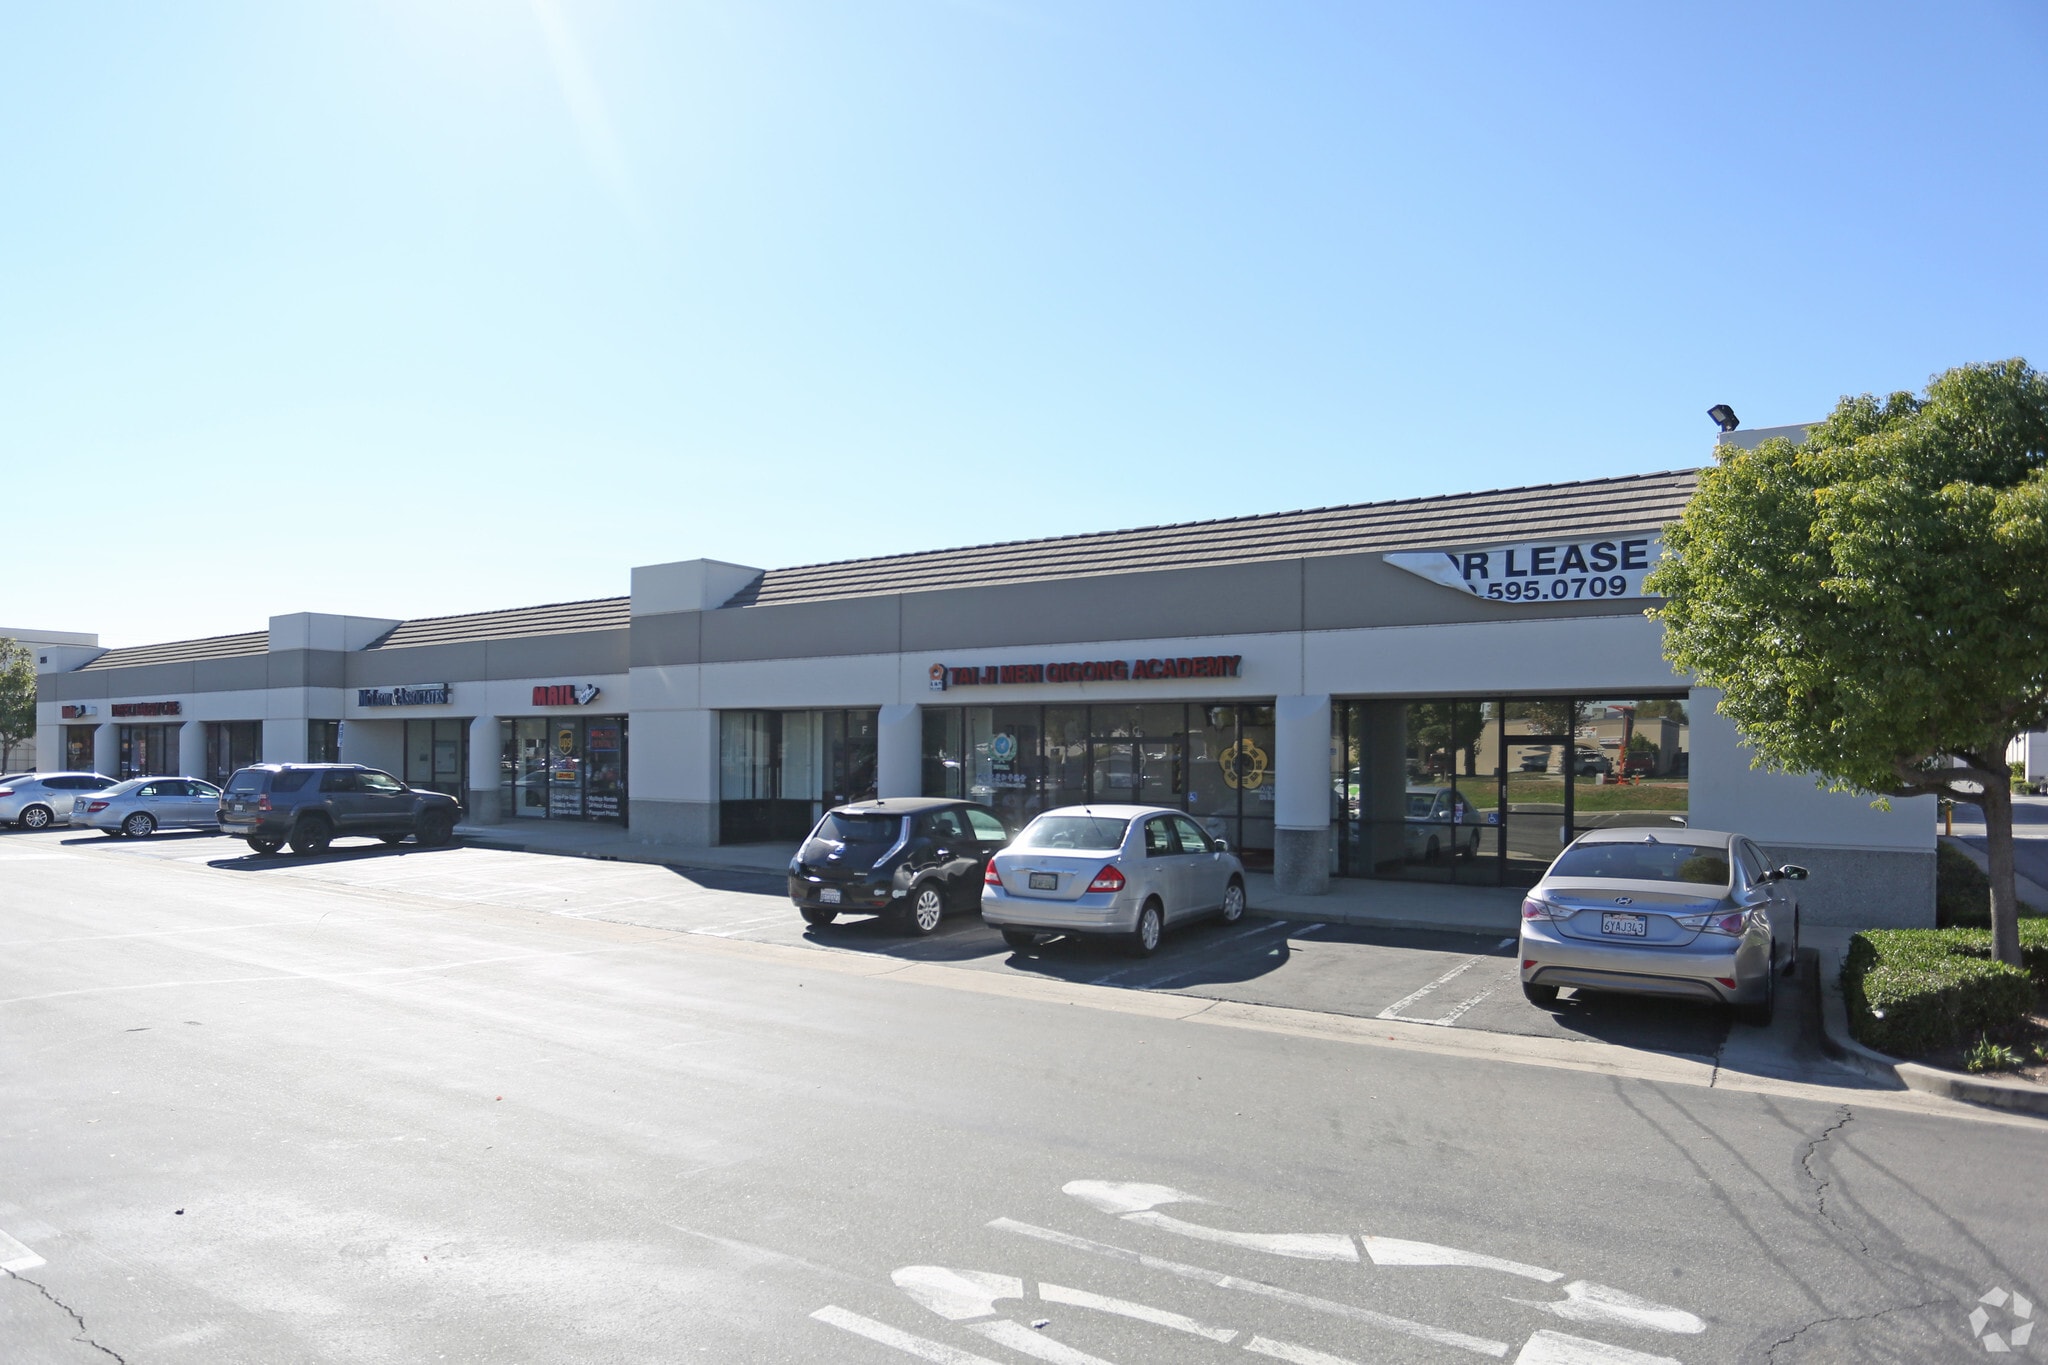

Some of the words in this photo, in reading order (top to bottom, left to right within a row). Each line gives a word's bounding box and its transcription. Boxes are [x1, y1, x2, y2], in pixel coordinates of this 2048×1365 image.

[1447, 553, 1489, 580] R
[1504, 539, 1648, 578] LEASE
[949, 666, 980, 685] TAI
[981, 665, 999, 684] JI
[1000, 663, 1044, 684] MEN
[1045, 660, 1129, 683] QIGONG
[1131, 655, 1242, 679] ACADEMY
[532, 685, 579, 706] MAIL
[861, 725, 868, 735] F
